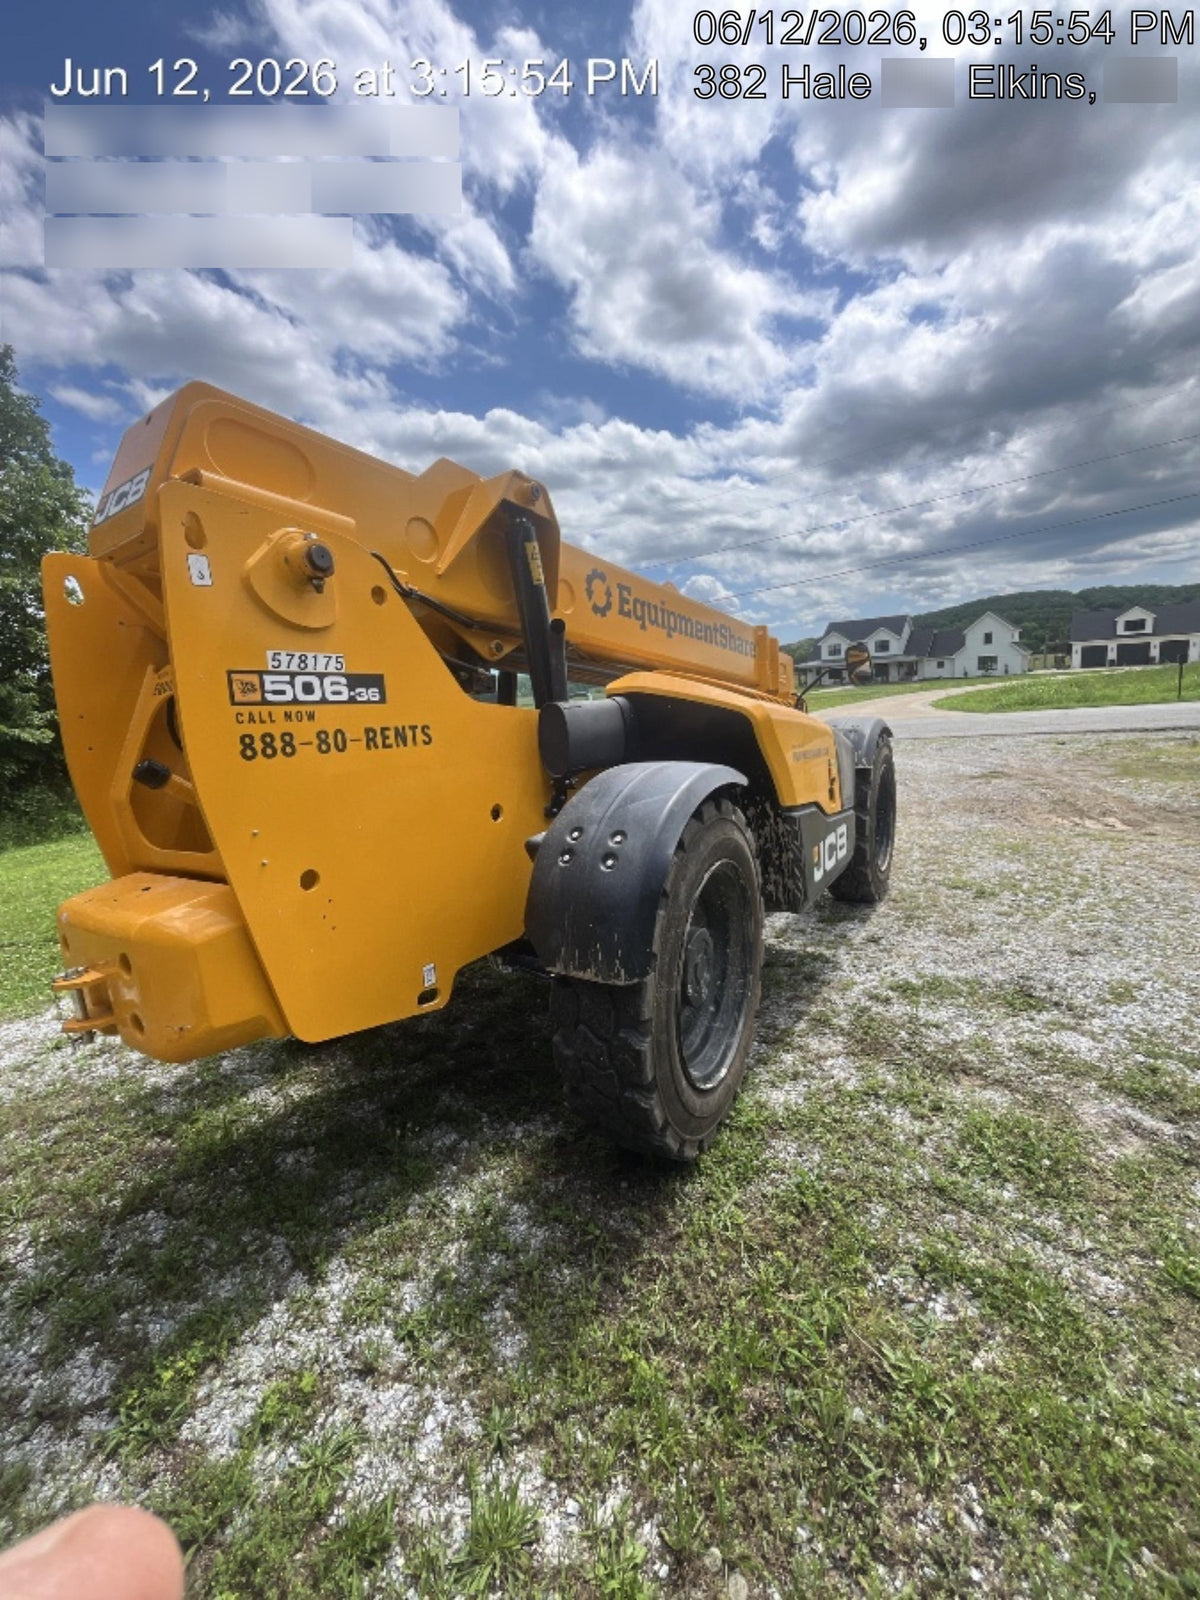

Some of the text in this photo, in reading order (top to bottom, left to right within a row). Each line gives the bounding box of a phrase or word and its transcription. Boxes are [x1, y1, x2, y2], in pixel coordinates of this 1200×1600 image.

[93, 468, 152, 527] JCB
[616, 583, 757, 659] EquipmentShare
[270, 652, 345, 672] 578175
[235, 710, 316, 725] CALL NOW
[239, 724, 434, 762] 888-80-RENTS
[813, 823, 848, 882] JCB
